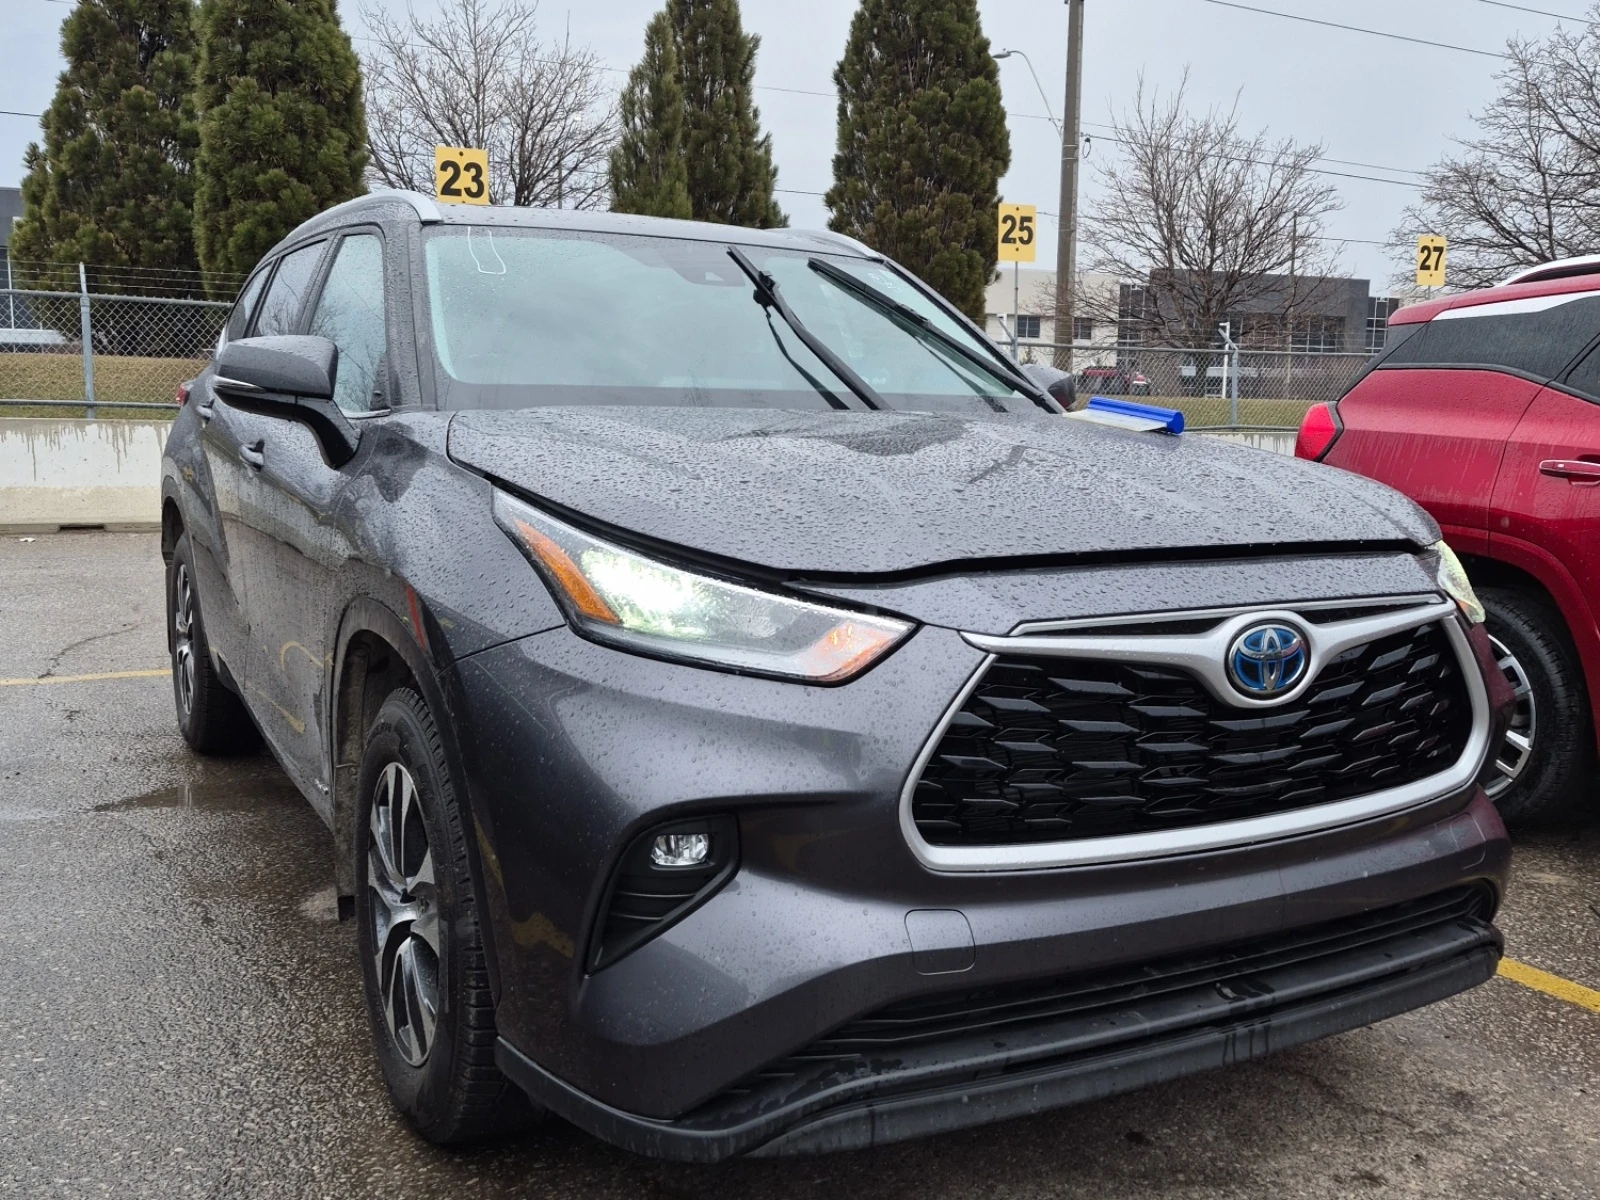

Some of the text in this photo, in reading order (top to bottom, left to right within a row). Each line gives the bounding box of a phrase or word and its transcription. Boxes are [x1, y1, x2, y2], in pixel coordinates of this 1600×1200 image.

[439, 160, 485, 199] 23
[1001, 214, 1034, 245] 25
[1419, 245, 1445, 272] 27
